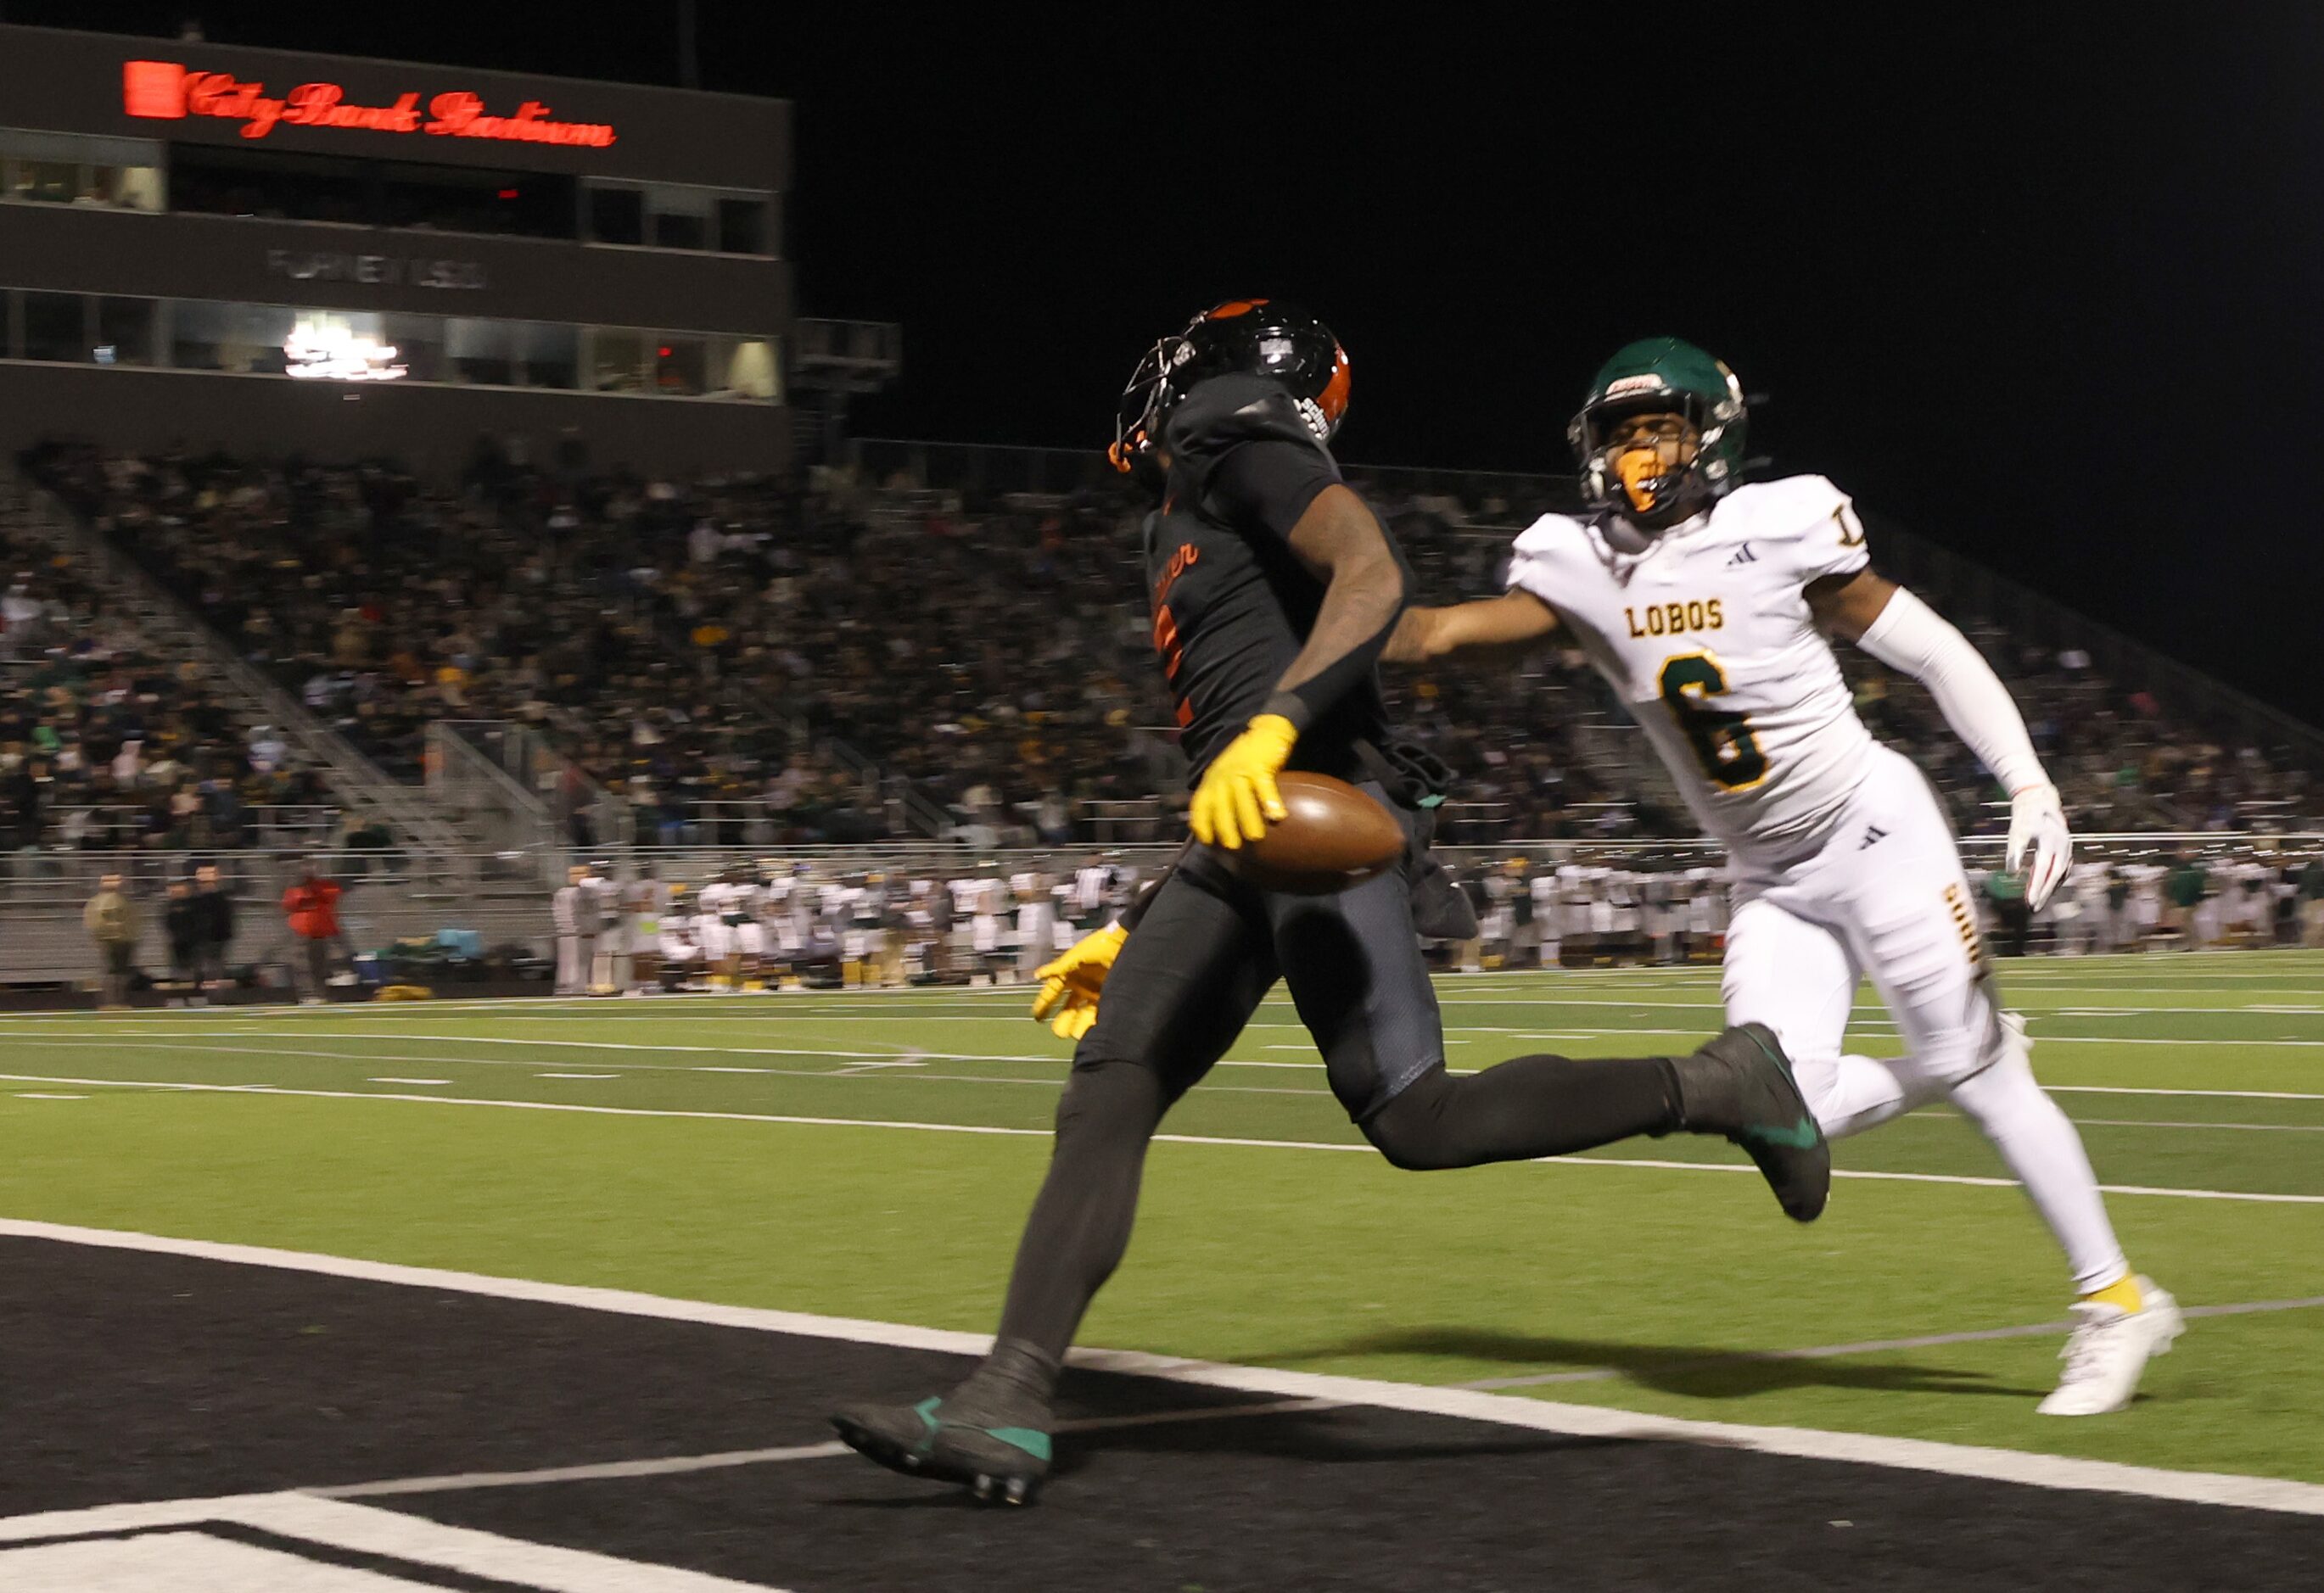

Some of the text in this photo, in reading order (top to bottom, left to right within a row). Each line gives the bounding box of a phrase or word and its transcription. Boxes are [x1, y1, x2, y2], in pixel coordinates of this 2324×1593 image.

[183, 71, 286, 138] City
[281, 82, 423, 133] Bank
[1624, 597, 1724, 640] LOBOS
[1658, 648, 1772, 791] 6
